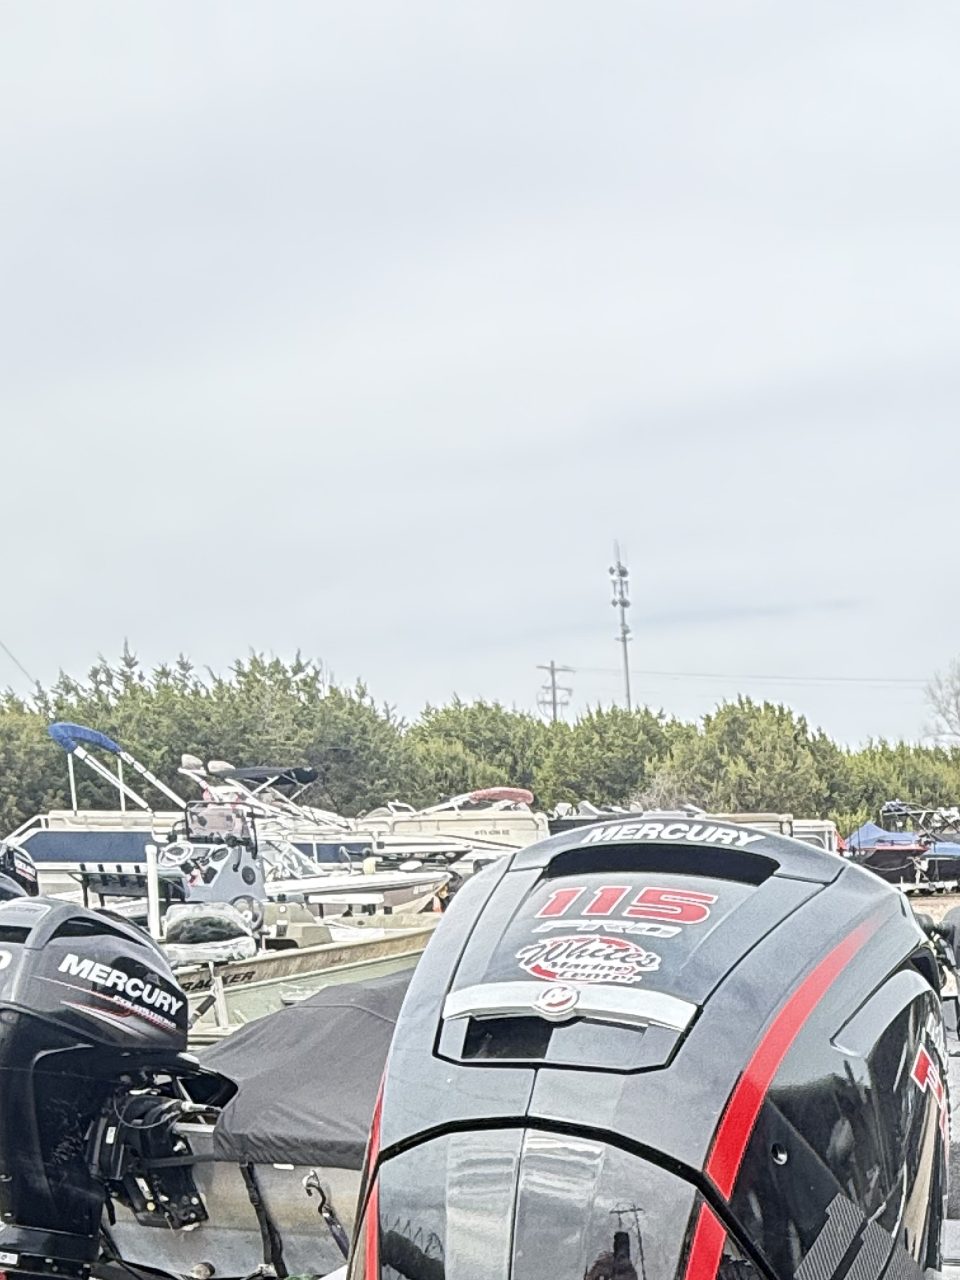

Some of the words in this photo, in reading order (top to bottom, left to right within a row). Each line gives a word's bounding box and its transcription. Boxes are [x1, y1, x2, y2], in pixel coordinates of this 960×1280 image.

[580, 823, 767, 848] MERCURY
[534, 885, 719, 925] 115
[531, 919, 682, 938] PRO
[58, 953, 184, 1016] MERCURY
